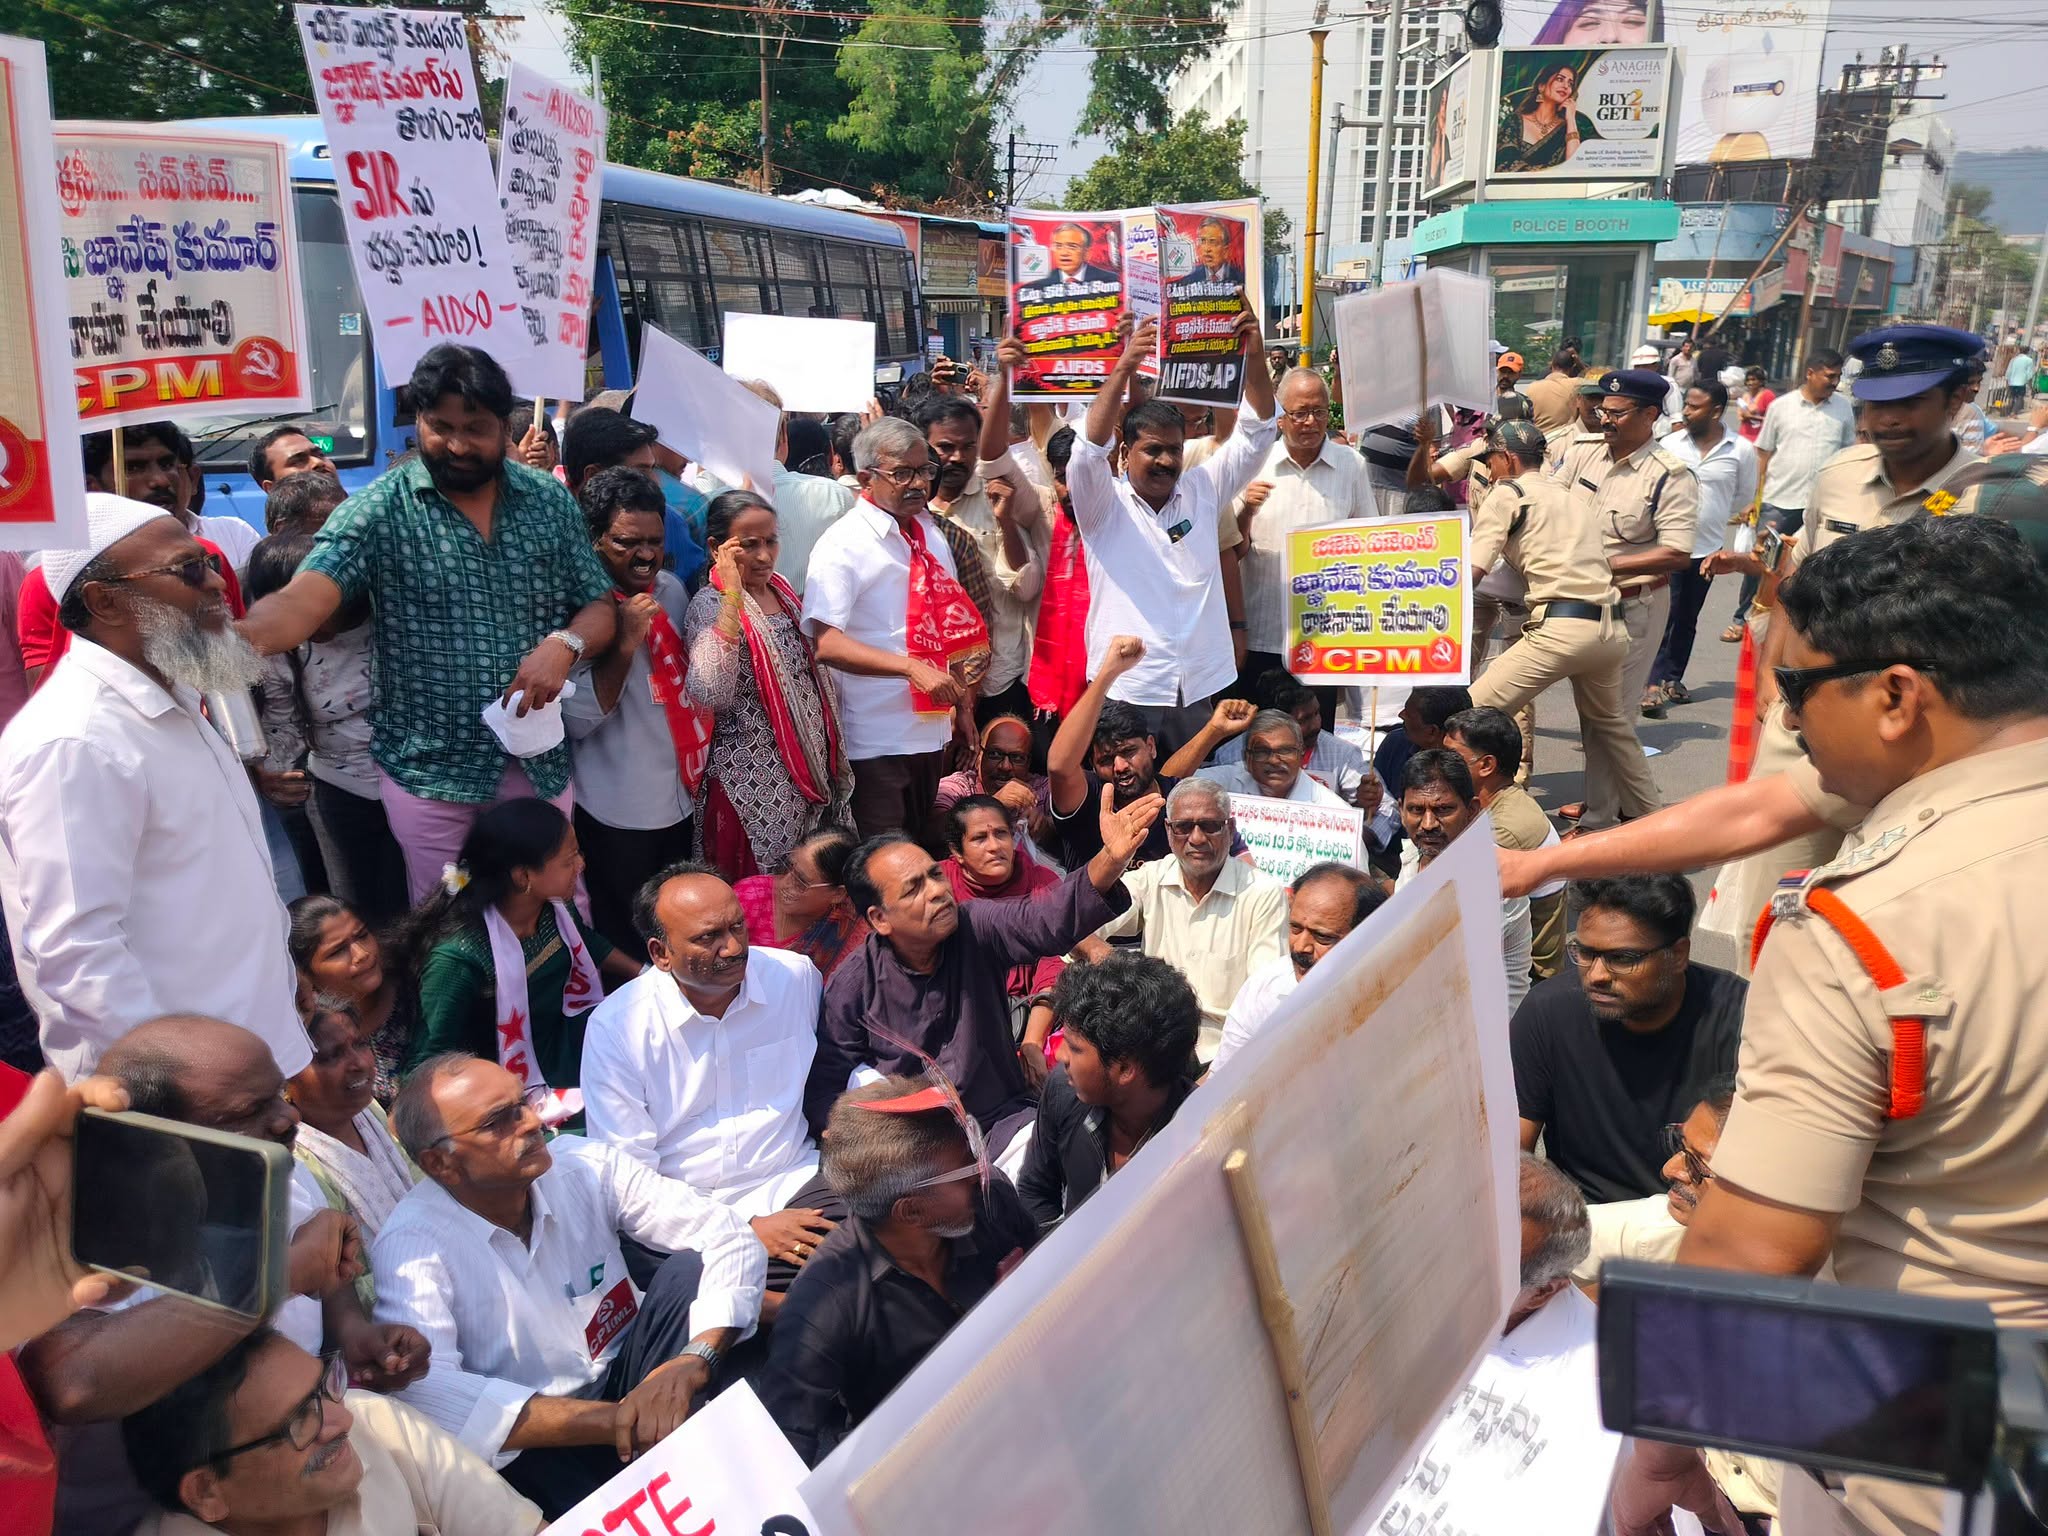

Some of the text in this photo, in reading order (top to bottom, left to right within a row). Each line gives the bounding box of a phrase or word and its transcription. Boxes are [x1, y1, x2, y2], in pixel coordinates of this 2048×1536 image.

[1611, 60, 1660, 73] ANAGHA
[1598, 88, 1643, 106] BUY 2
[1596, 107, 1631, 121] GET
[1631, 107, 1642, 121] 1
[346, 150, 412, 220] SIR
[1513, 219, 1629, 232] POLICE BOOTH
[173, 217, 281, 273] కుమార్
[422, 289, 493, 337] AIDSO
[1052, 360, 1106, 374] AIFDS
[1161, 362, 1237, 390] AIFDS-AP
[1368, 558, 1460, 591] కుమార్
[933, 582, 963, 594] CITU
[943, 625, 981, 640] CITU
[913, 633, 943, 651] CITU
[1322, 648, 1422, 673] CPM
[1272, 833, 1295, 850] 13.5
